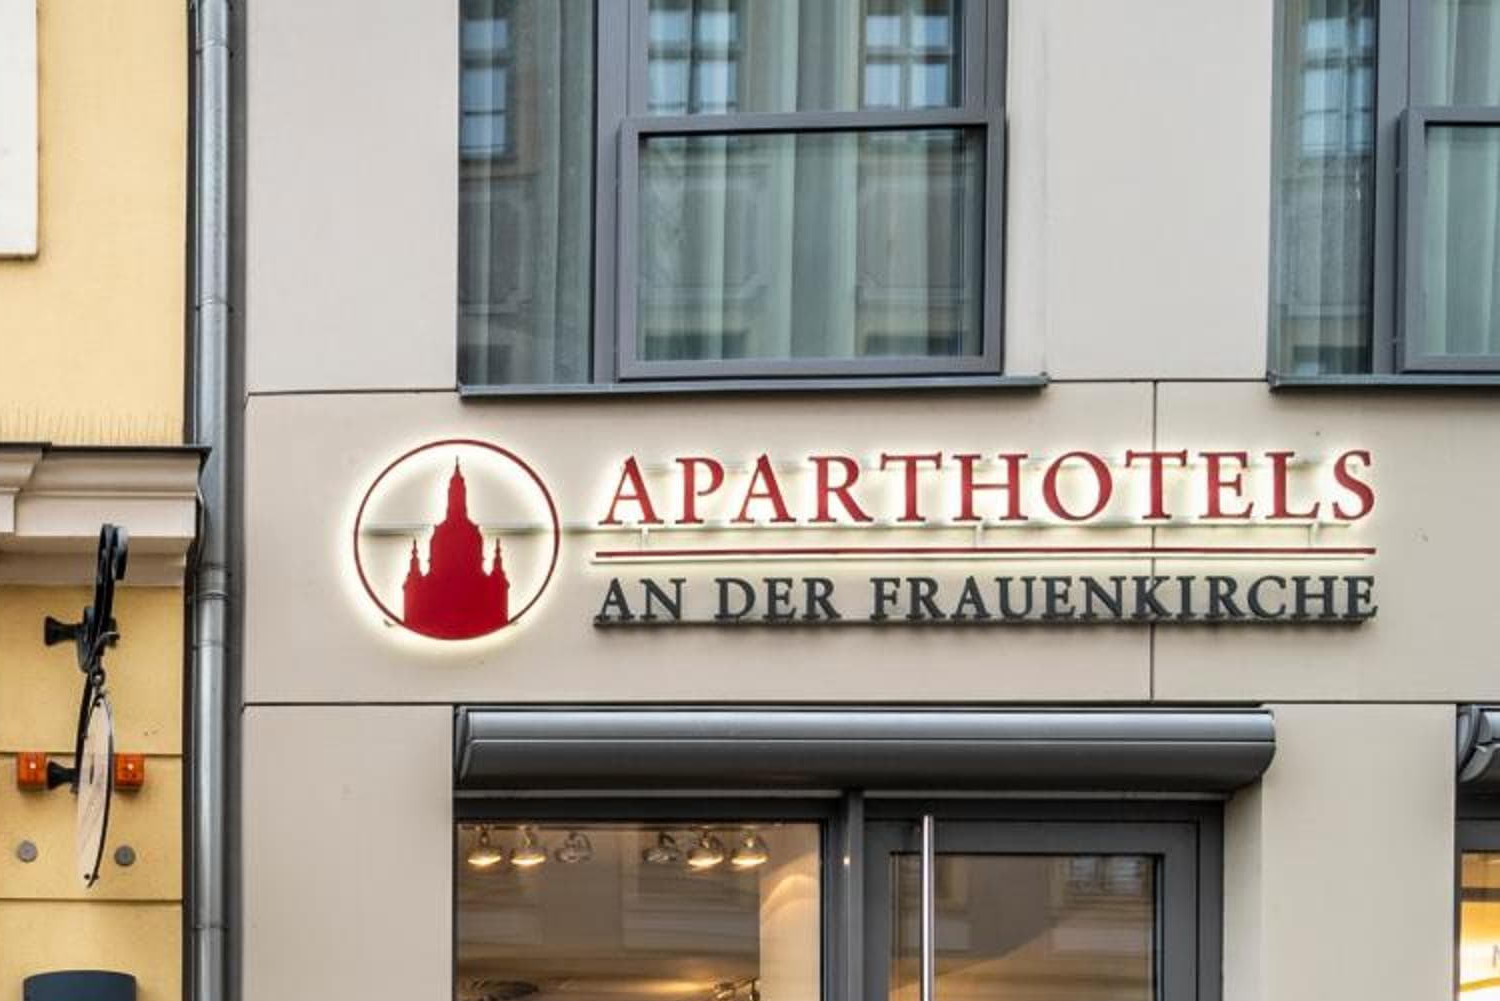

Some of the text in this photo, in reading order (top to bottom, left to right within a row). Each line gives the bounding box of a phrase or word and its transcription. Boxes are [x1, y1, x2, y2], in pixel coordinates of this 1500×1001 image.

[598, 448, 1376, 527] APARTHOTELS
[594, 575, 1380, 621] AN DER FRAUENKIRCHE
